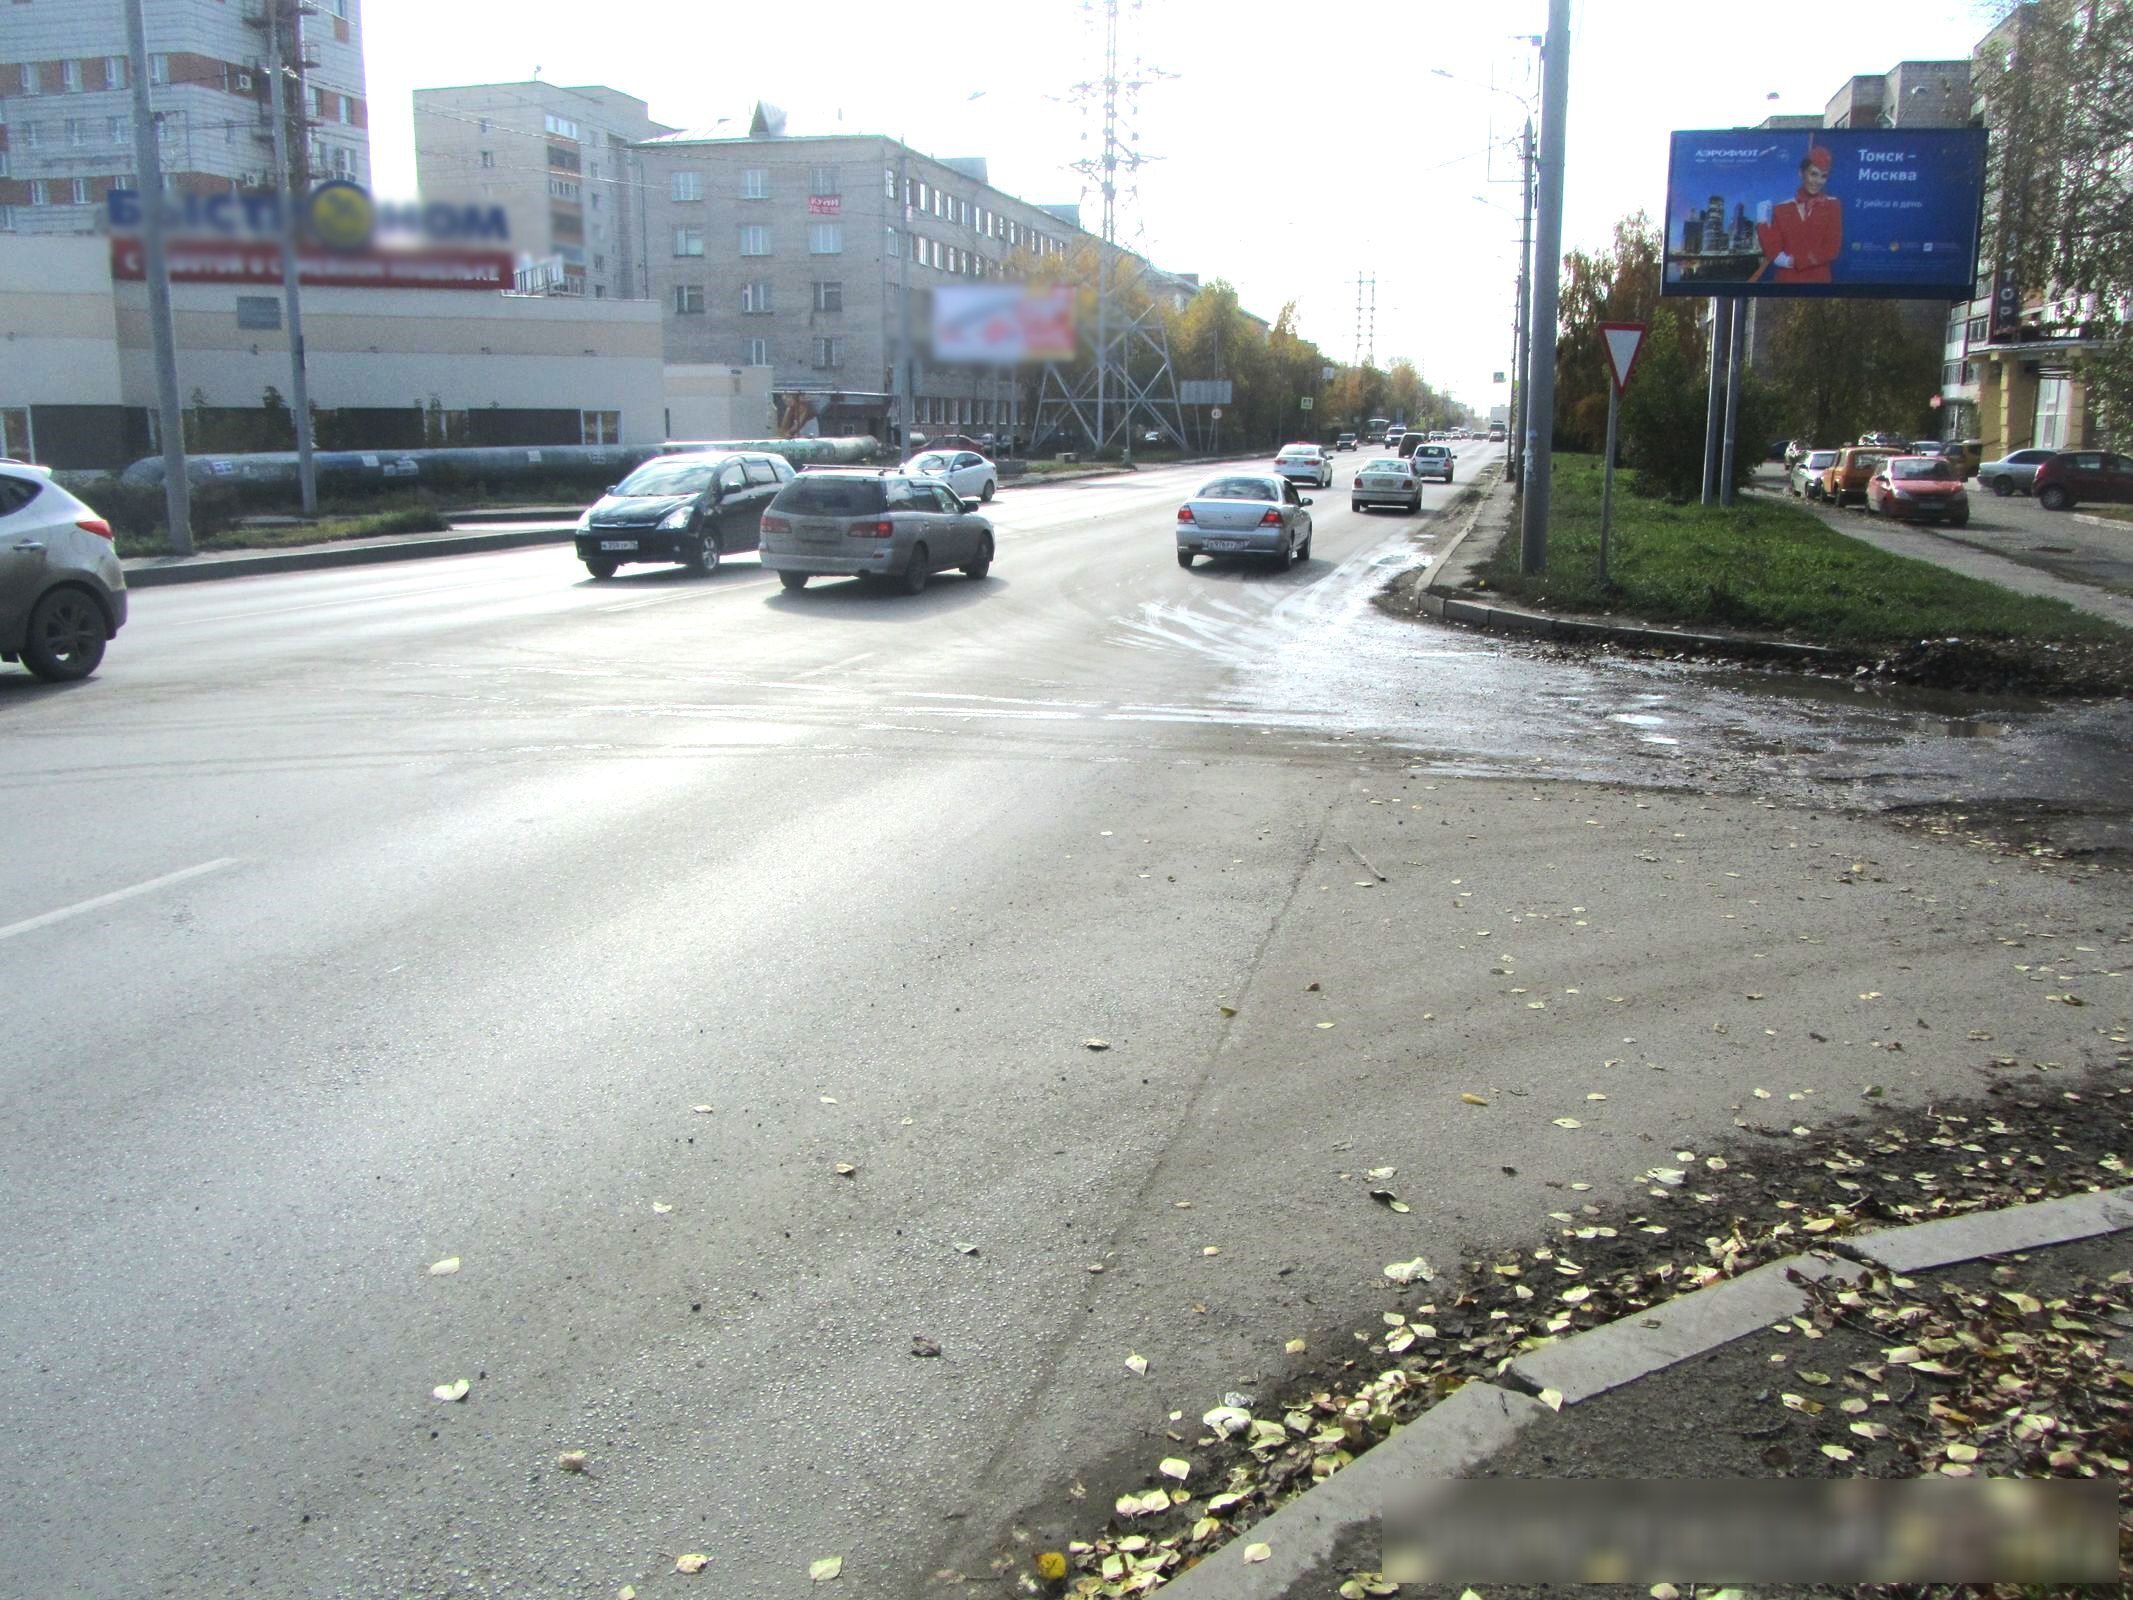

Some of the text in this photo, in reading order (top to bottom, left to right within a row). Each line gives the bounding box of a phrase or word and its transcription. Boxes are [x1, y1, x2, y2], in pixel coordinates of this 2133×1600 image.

[1695, 149, 1759, 158] АЭРОФЛОТ
[1858, 149, 1904, 162] Томск
[1859, 168, 1917, 181] Москва
[1864, 199, 1891, 209] рейса
[1900, 201, 1923, 209] день
